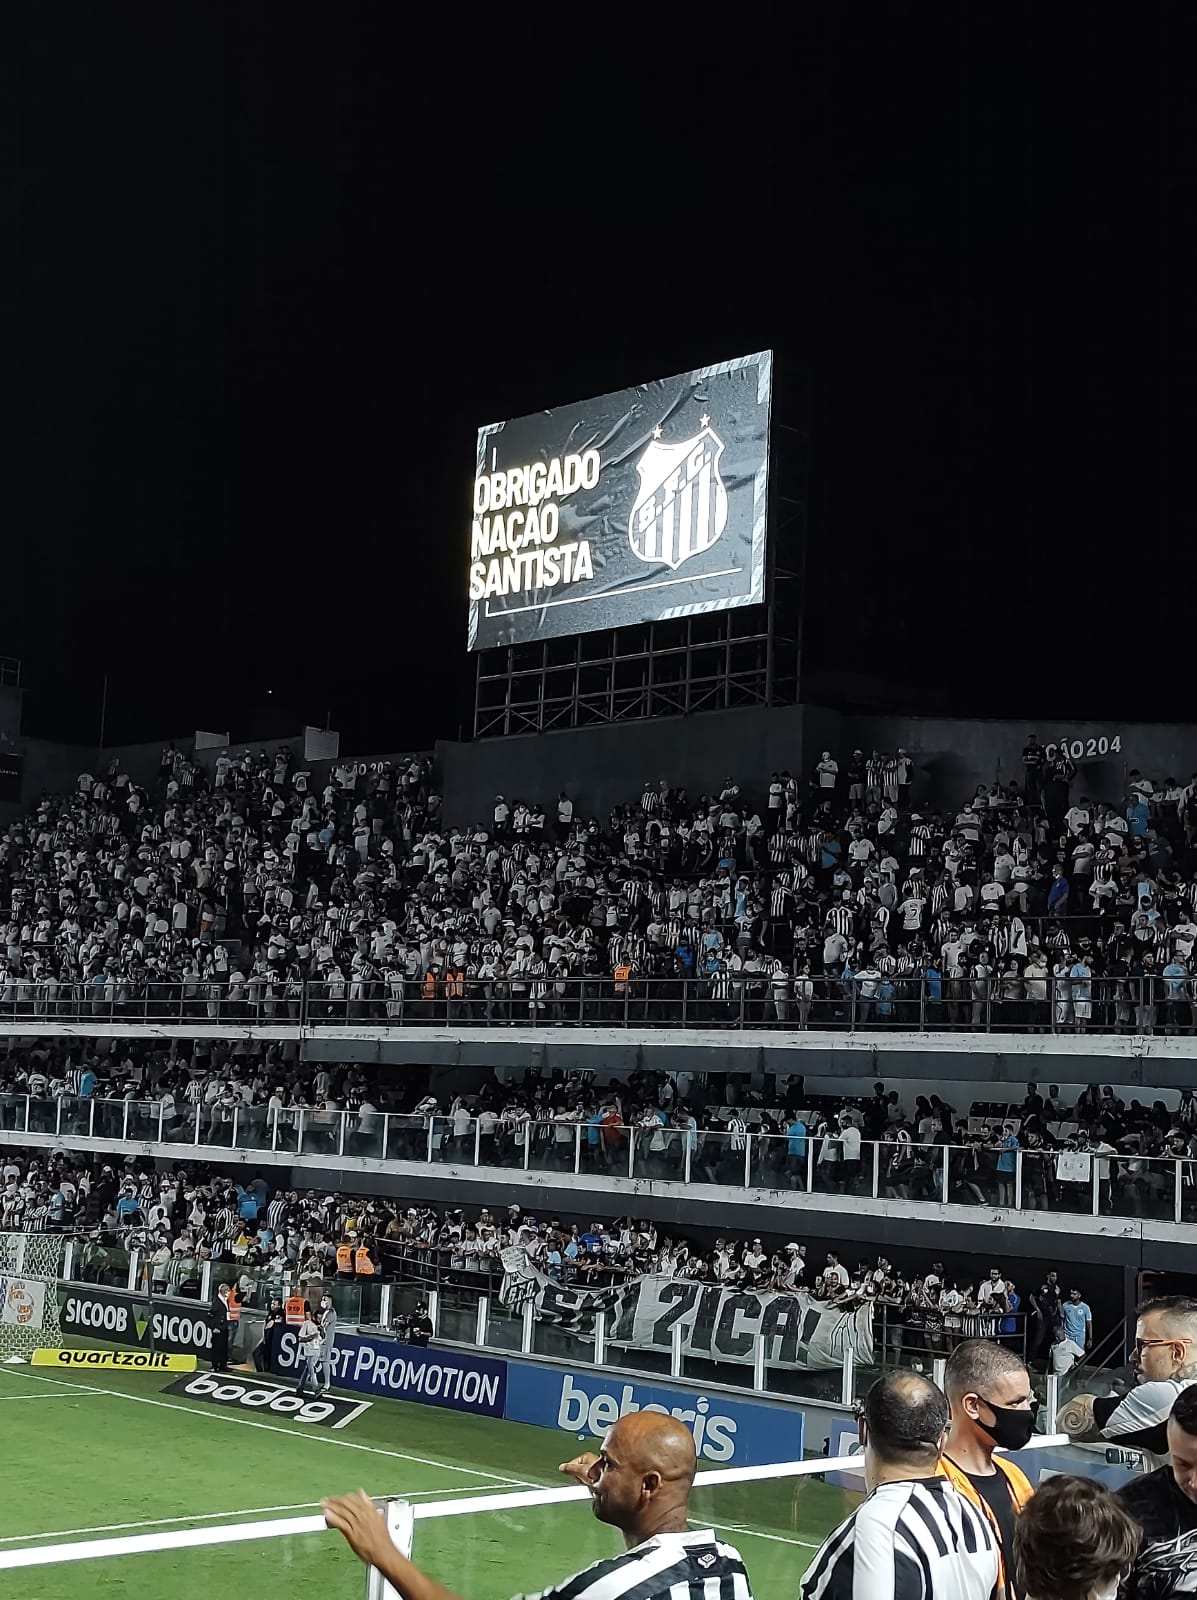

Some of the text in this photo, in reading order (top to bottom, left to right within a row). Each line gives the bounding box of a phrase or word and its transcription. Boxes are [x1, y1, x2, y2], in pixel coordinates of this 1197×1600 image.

[473, 450, 601, 515] OBRIGADO
[470, 502, 560, 561] NAÇÃO
[469, 541, 594, 600] SANTISTA
[65, 1298, 128, 1332] SICOOB
[58, 1351, 171, 1368] quartzolit
[277, 1331, 500, 1406] SPRTPROMOTION
[184, 1373, 335, 1423] bodog
